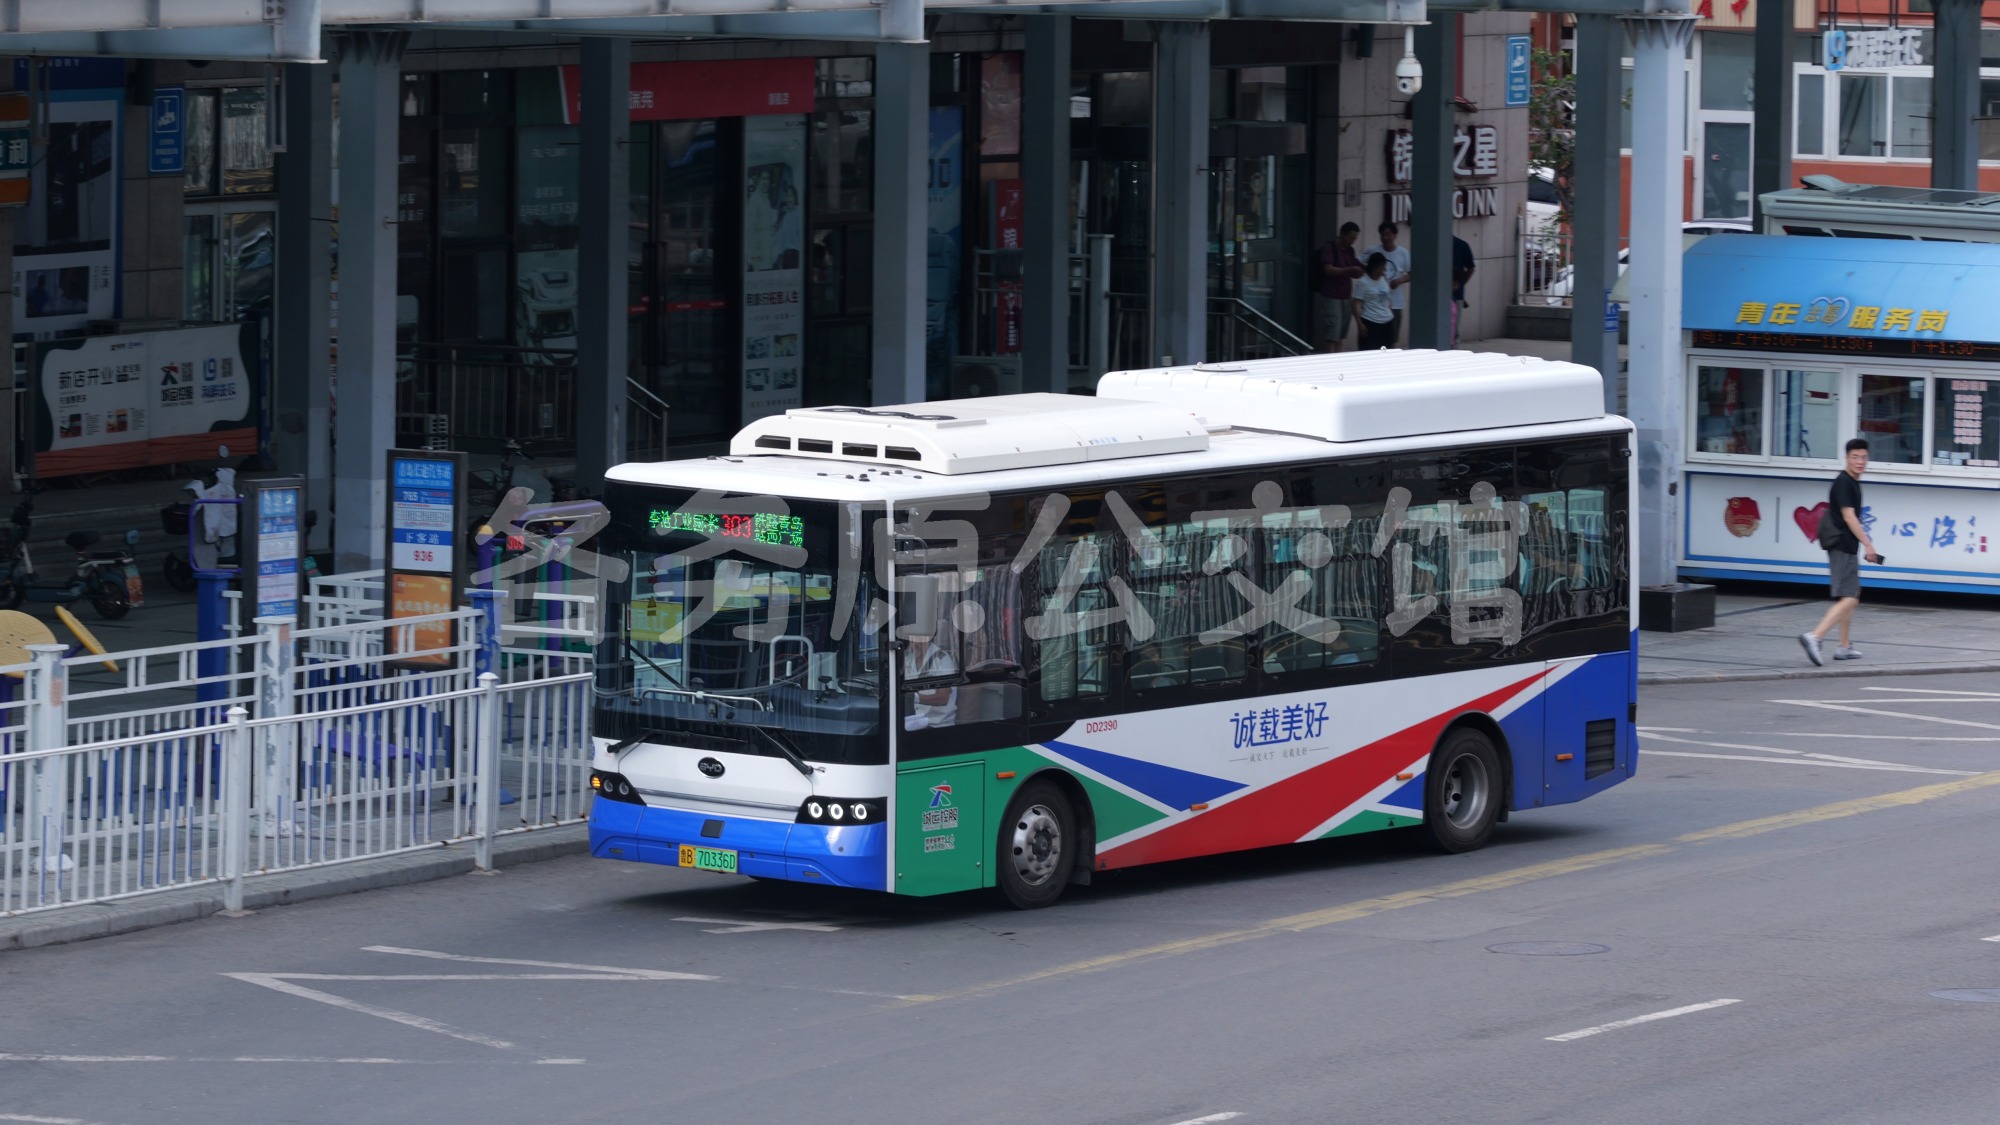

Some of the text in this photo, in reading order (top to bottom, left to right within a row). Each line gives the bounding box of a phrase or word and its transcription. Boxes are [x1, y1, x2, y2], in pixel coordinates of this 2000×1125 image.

[1393, 127, 1498, 181] 锦之星
[1467, 189, 1498, 217] INN
[59, 367, 114, 389] 新店开业
[649, 509, 705, 533] 李沧工业园
[722, 513, 752, 539] 303
[754, 512, 803, 532] 铁路青岛
[405, 532, 440, 545] 下客站
[754, 527, 803, 548] 站西广场
[413, 550, 434, 562] 936
[1086, 719, 1118, 734] DD2390
[1229, 701, 1329, 749] 诚载美好
[699, 762, 723, 774] BYD
